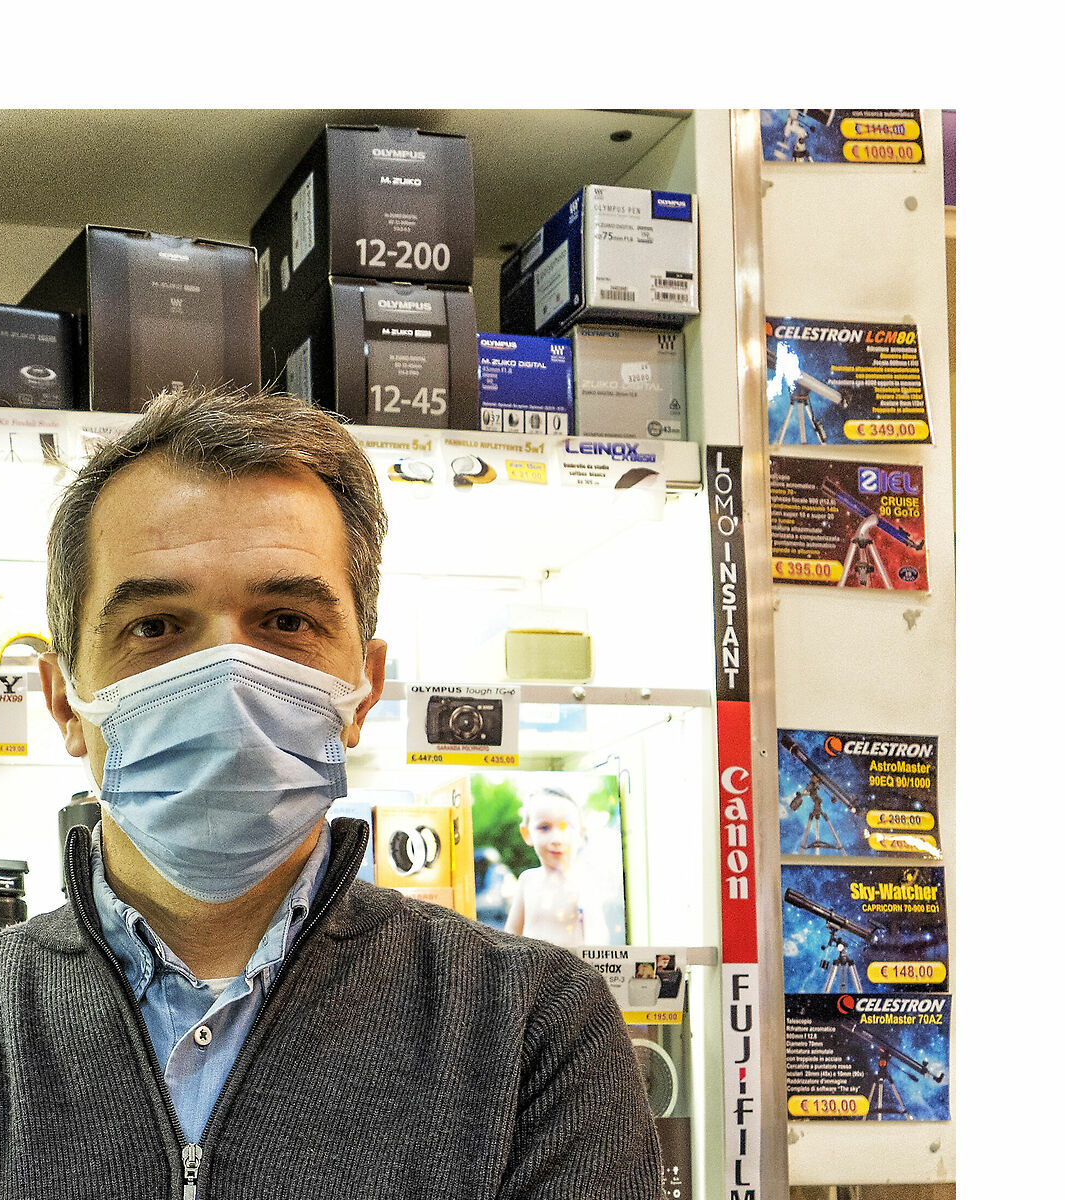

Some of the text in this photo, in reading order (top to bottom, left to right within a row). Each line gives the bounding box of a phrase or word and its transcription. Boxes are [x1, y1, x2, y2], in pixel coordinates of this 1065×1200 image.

[371, 148, 427, 160] OLYMPUS
[356, 238, 452, 272] 12-200
[377, 299, 433, 311] OLYMPUS
[774, 325, 916, 345] CELESTRON LCM80
[480, 339, 518, 349] OLYMPUS
[518, 360, 547, 368] DIGITAL
[369, 384, 449, 416] 12-45
[857, 423, 916, 437] € 349,00
[564, 440, 640, 456] LEINOX
[880, 495, 920, 508] CRUISE
[879, 506, 920, 518] 90 GoTo
[719, 541, 740, 690] INSTANT
[843, 740, 933, 758] CELESTRON
[869, 760, 931, 774] AstroMaster
[869, 775, 931, 789] 90EQ 90/1000
[720, 765, 750, 901] Canon
[850, 882, 939, 902] Sky-Watcher
[582, 949, 629, 960] FUJIFILM
[594, 962, 622, 974] nstax
[881, 965, 935, 980] € 148,00
[855, 998, 946, 1013] CELESTRON
[859, 1013, 943, 1025] AstroMaster 70AZ
[800, 1099, 857, 1114] € 130,00
